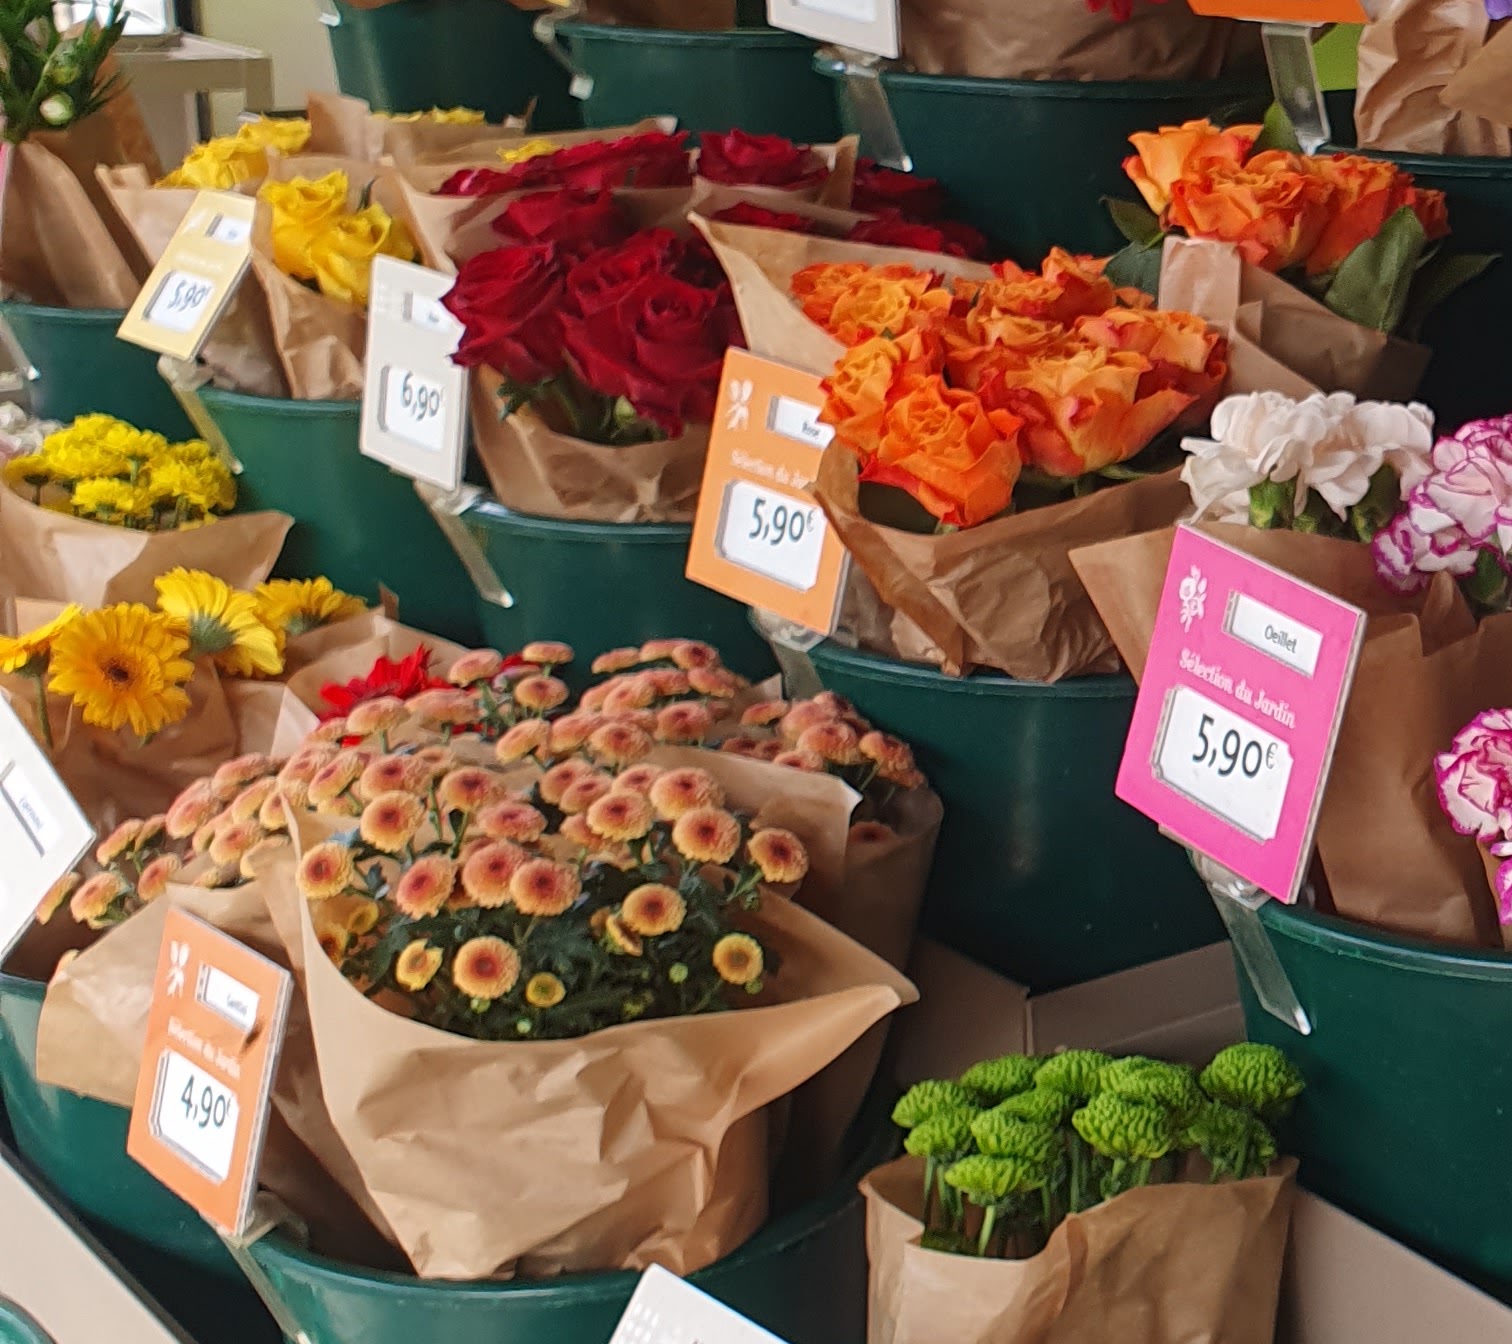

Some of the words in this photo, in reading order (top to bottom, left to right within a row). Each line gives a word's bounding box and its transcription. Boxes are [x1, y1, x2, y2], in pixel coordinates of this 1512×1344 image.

[1234, 678, 1254, 706] du
[1253, 688, 1296, 730] Jardin
[1191, 713, 1279, 779] 5,90€
